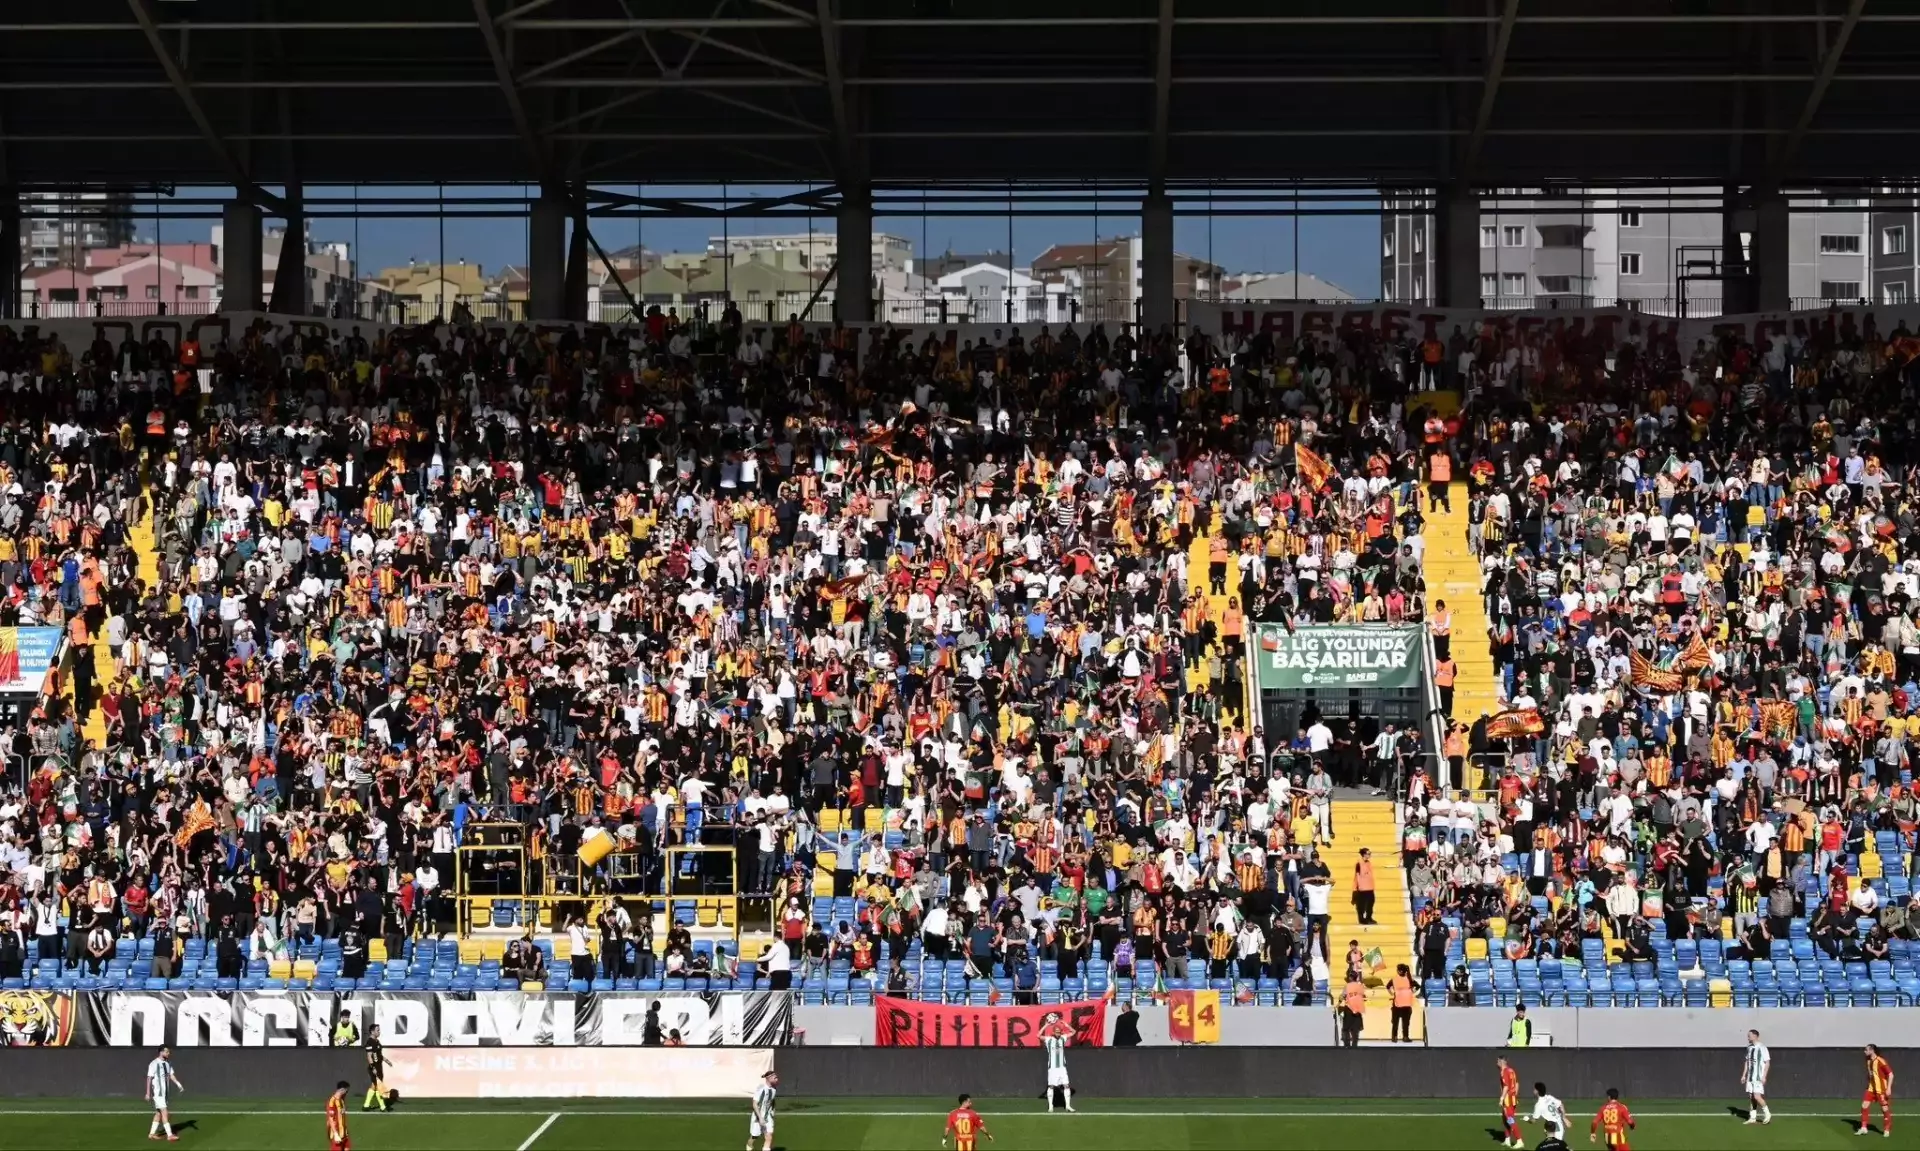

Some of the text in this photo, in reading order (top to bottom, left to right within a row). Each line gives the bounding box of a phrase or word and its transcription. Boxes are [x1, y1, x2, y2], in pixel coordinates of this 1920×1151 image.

[1292, 637, 1318, 651] LİG
[1322, 638, 1407, 651] YOLUNDA
[1272, 652, 1407, 673] BAŞARILAR
[435, 1050, 517, 1072] NESİNE
[1603, 1108, 1619, 1124] 88
[955, 1118, 971, 1134] 10
